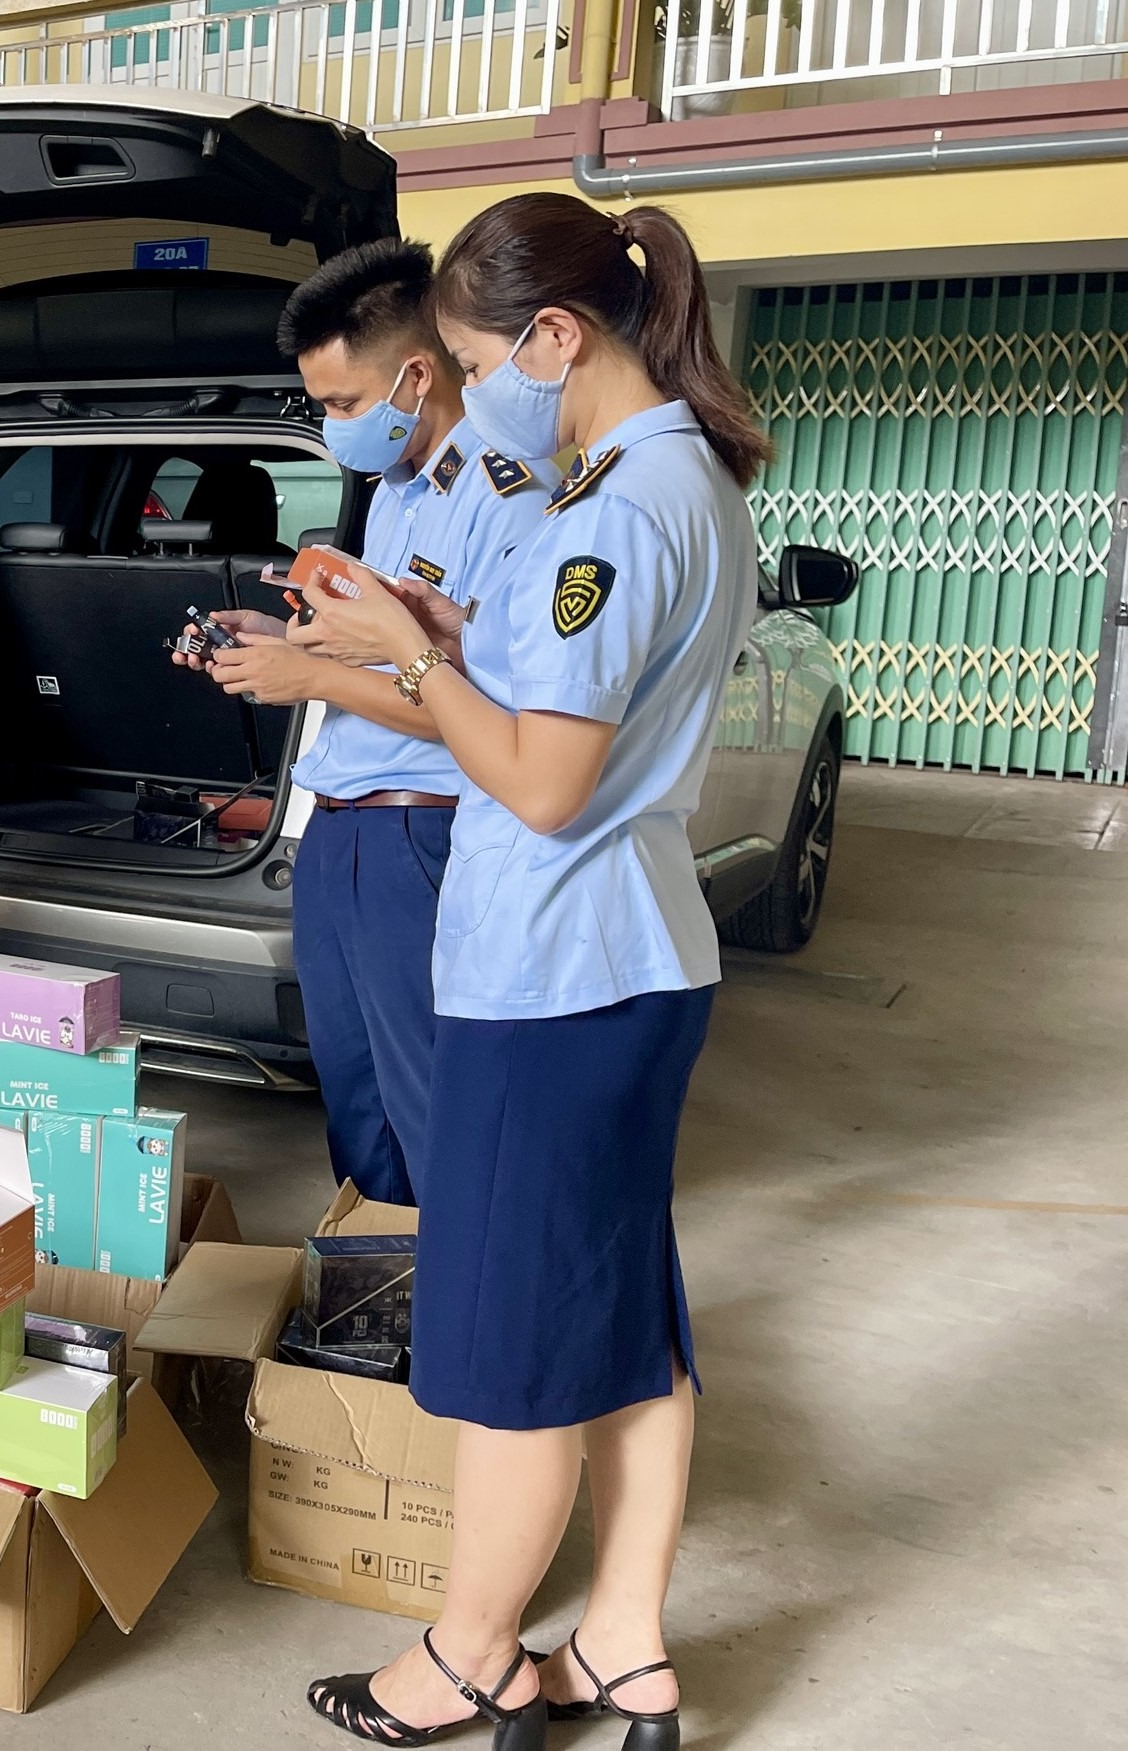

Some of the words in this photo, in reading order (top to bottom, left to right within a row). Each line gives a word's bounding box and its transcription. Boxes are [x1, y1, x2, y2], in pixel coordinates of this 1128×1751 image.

[154, 246, 188, 261] 20A
[565, 564, 598, 580] DMS
[10, 1011, 29, 1022] TARO
[30, 1014, 42, 1025] ICE
[1, 1021, 51, 1045] LAVIE
[10, 1080, 33, 1090] MINT
[34, 1081, 49, 1091] ICE
[0, 1091, 58, 1109] LAVIE
[140, 1172, 148, 1189] ICE
[138, 1190, 147, 1213] MINT
[149, 1166, 168, 1224] LAVIE
[48, 1193, 56, 1216] MINT
[353, 1315, 369, 1329] 10
[40, 1408, 73, 1429] 8000
[316, 1466, 331, 1476] KG
[313, 1480, 328, 1490] KG
[268, 1490, 292, 1503] SIZE:
[296, 1496, 377, 1520] 390X305X290MM
[402, 1501, 413, 1511] 10
[416, 1504, 437, 1516] PCS
[400, 1513, 419, 1523] 240
[421, 1516, 442, 1528] PCS
[269, 1548, 297, 1562] MADE
[299, 1555, 308, 1563] IN
[310, 1558, 340, 1571] CHINA
